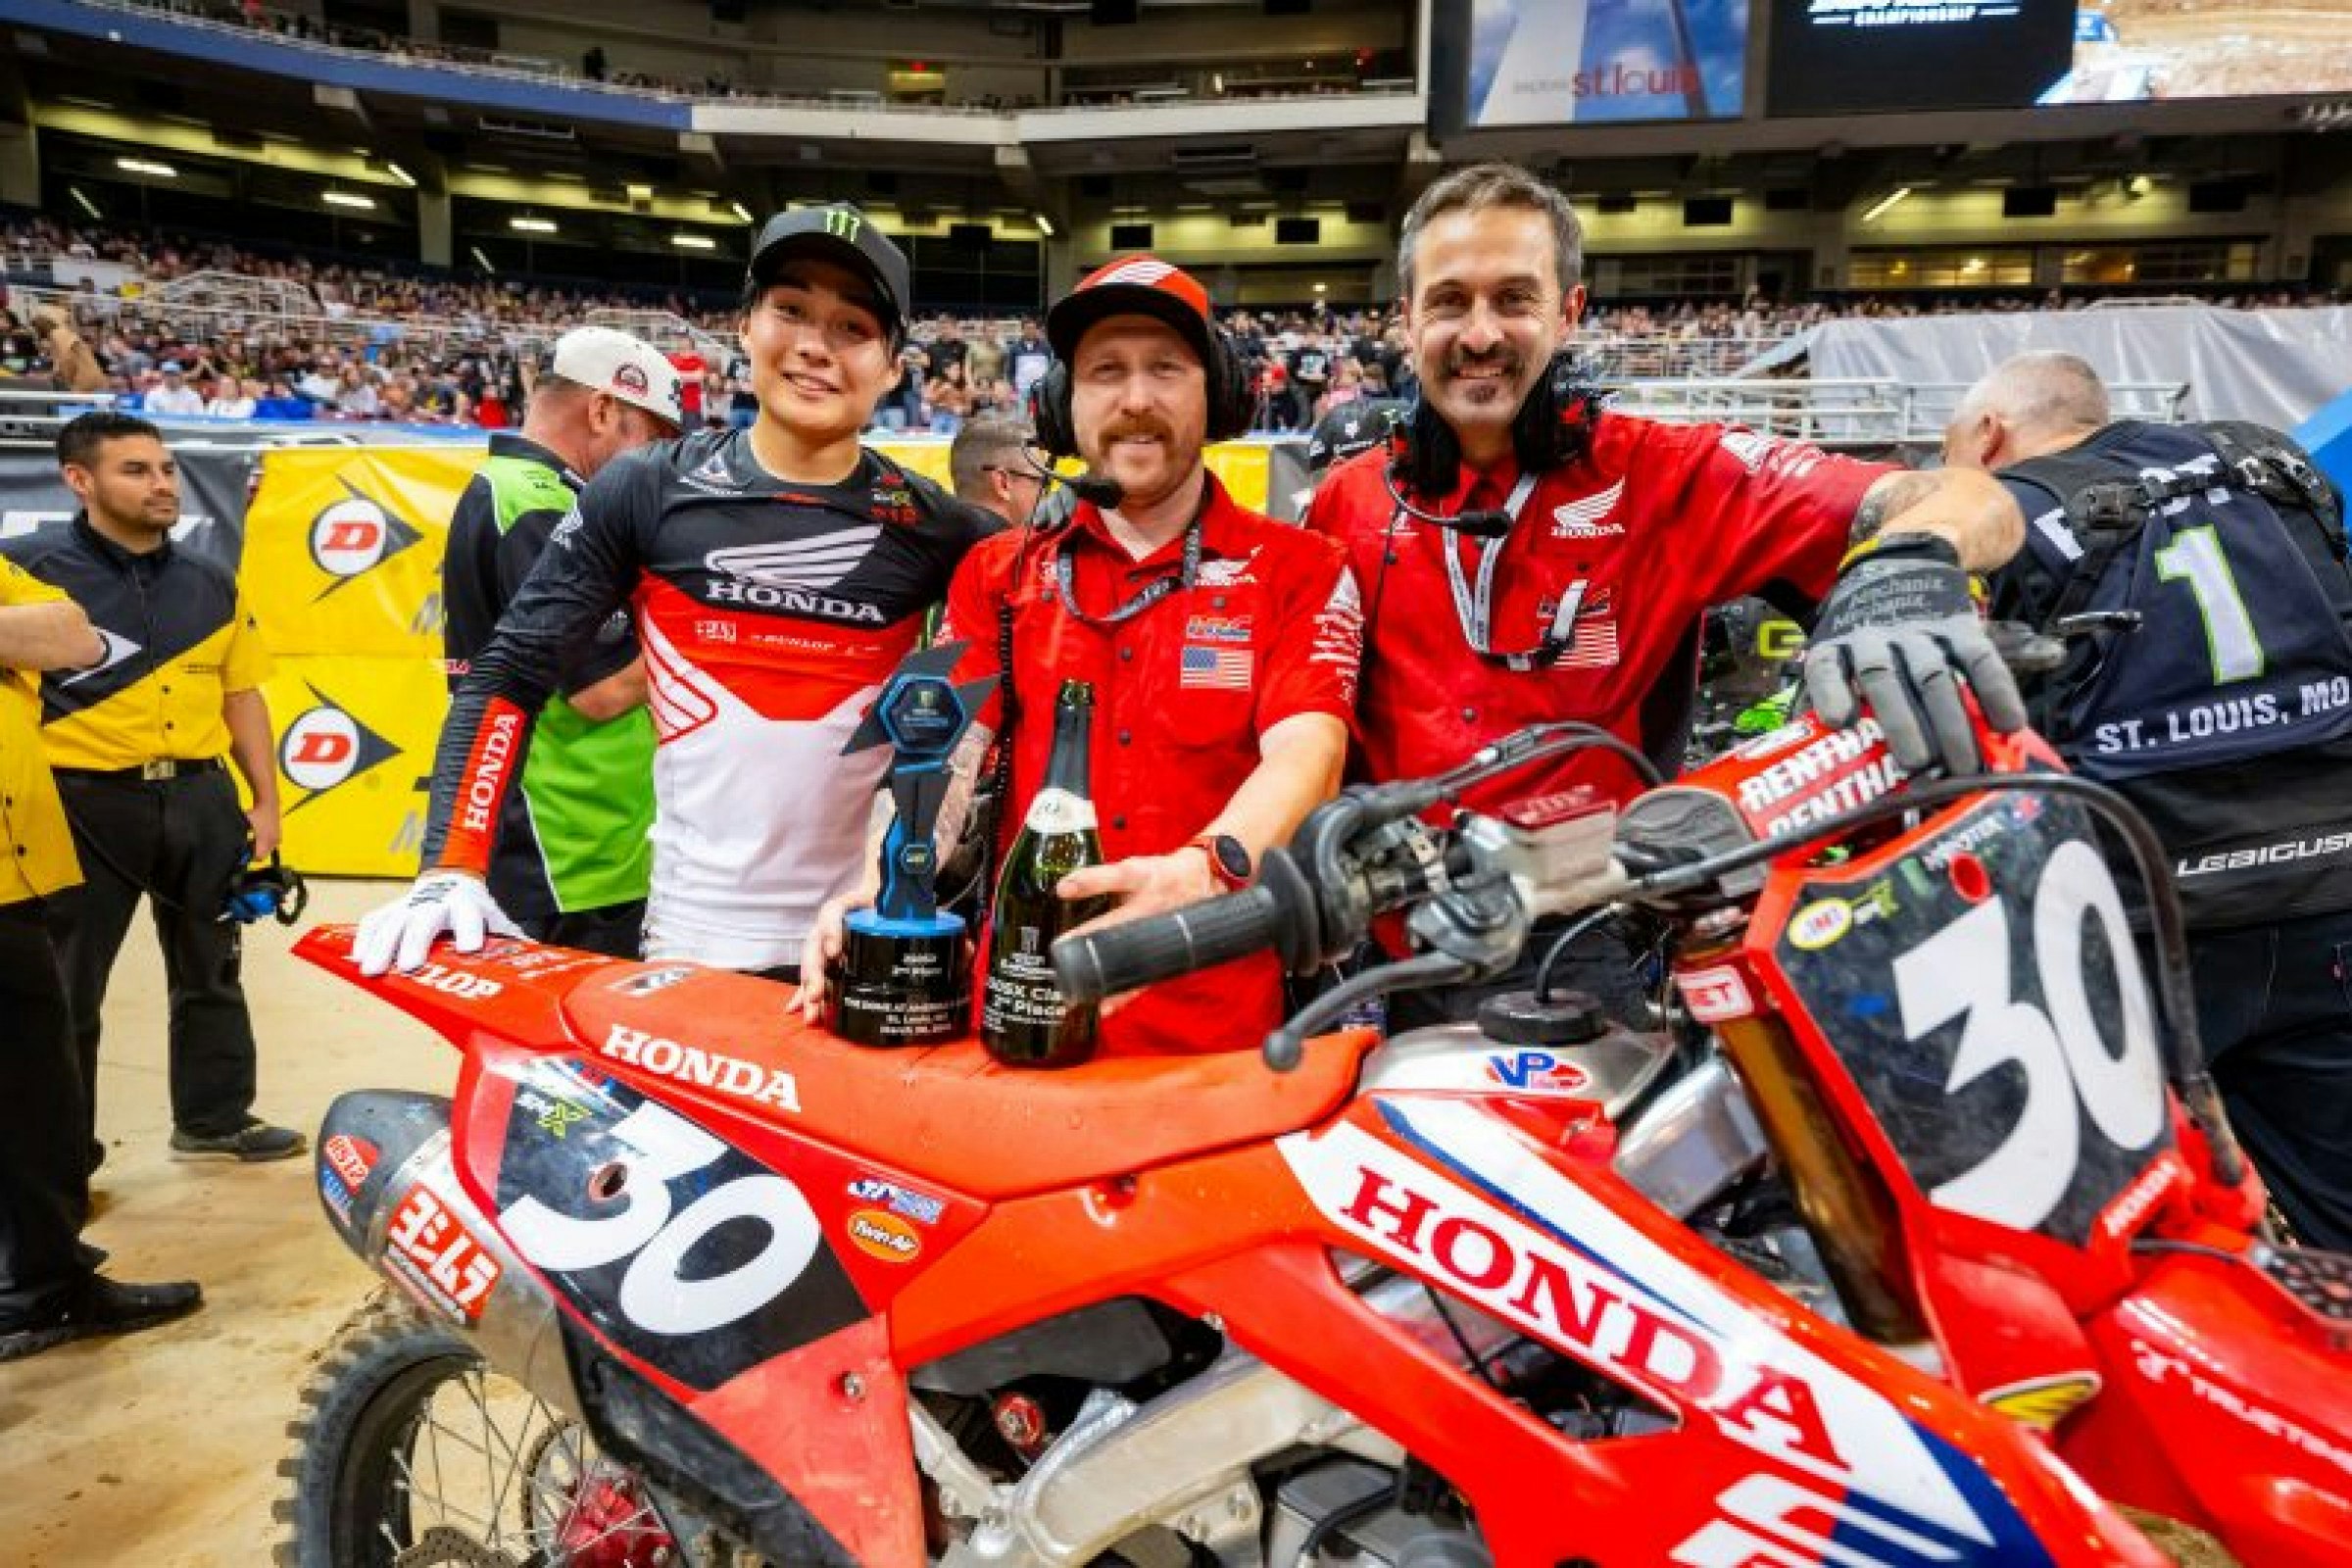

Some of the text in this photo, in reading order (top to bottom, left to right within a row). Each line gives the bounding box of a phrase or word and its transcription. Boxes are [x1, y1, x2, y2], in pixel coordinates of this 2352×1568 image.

[1853, 5, 1977, 26] CHAMPIONSHIP
[319, 520, 381, 555] D
[1551, 521, 1627, 539] HONDA
[706, 579, 886, 624] HONDA
[2155, 523, 2265, 686] 1
[2095, 675, 2349, 753] ST. LOUIS, MO
[290, 731, 352, 765] D
[463, 713, 519, 833] HONDA
[1736, 716, 1886, 813] RENTHA
[1014, 999, 1067, 1016] Place
[1029, 987, 1064, 1003] Cla
[1892, 839, 2166, 1231] 30
[601, 1023, 802, 1113] HONDA
[1489, 1052, 1556, 1089] VP
[388, 1190, 499, 1305] ヨシムラ
[497, 1099, 822, 1337] 30
[853, 1218, 917, 1252] Twin Air
[1339, 1164, 1852, 1471] HONDA
